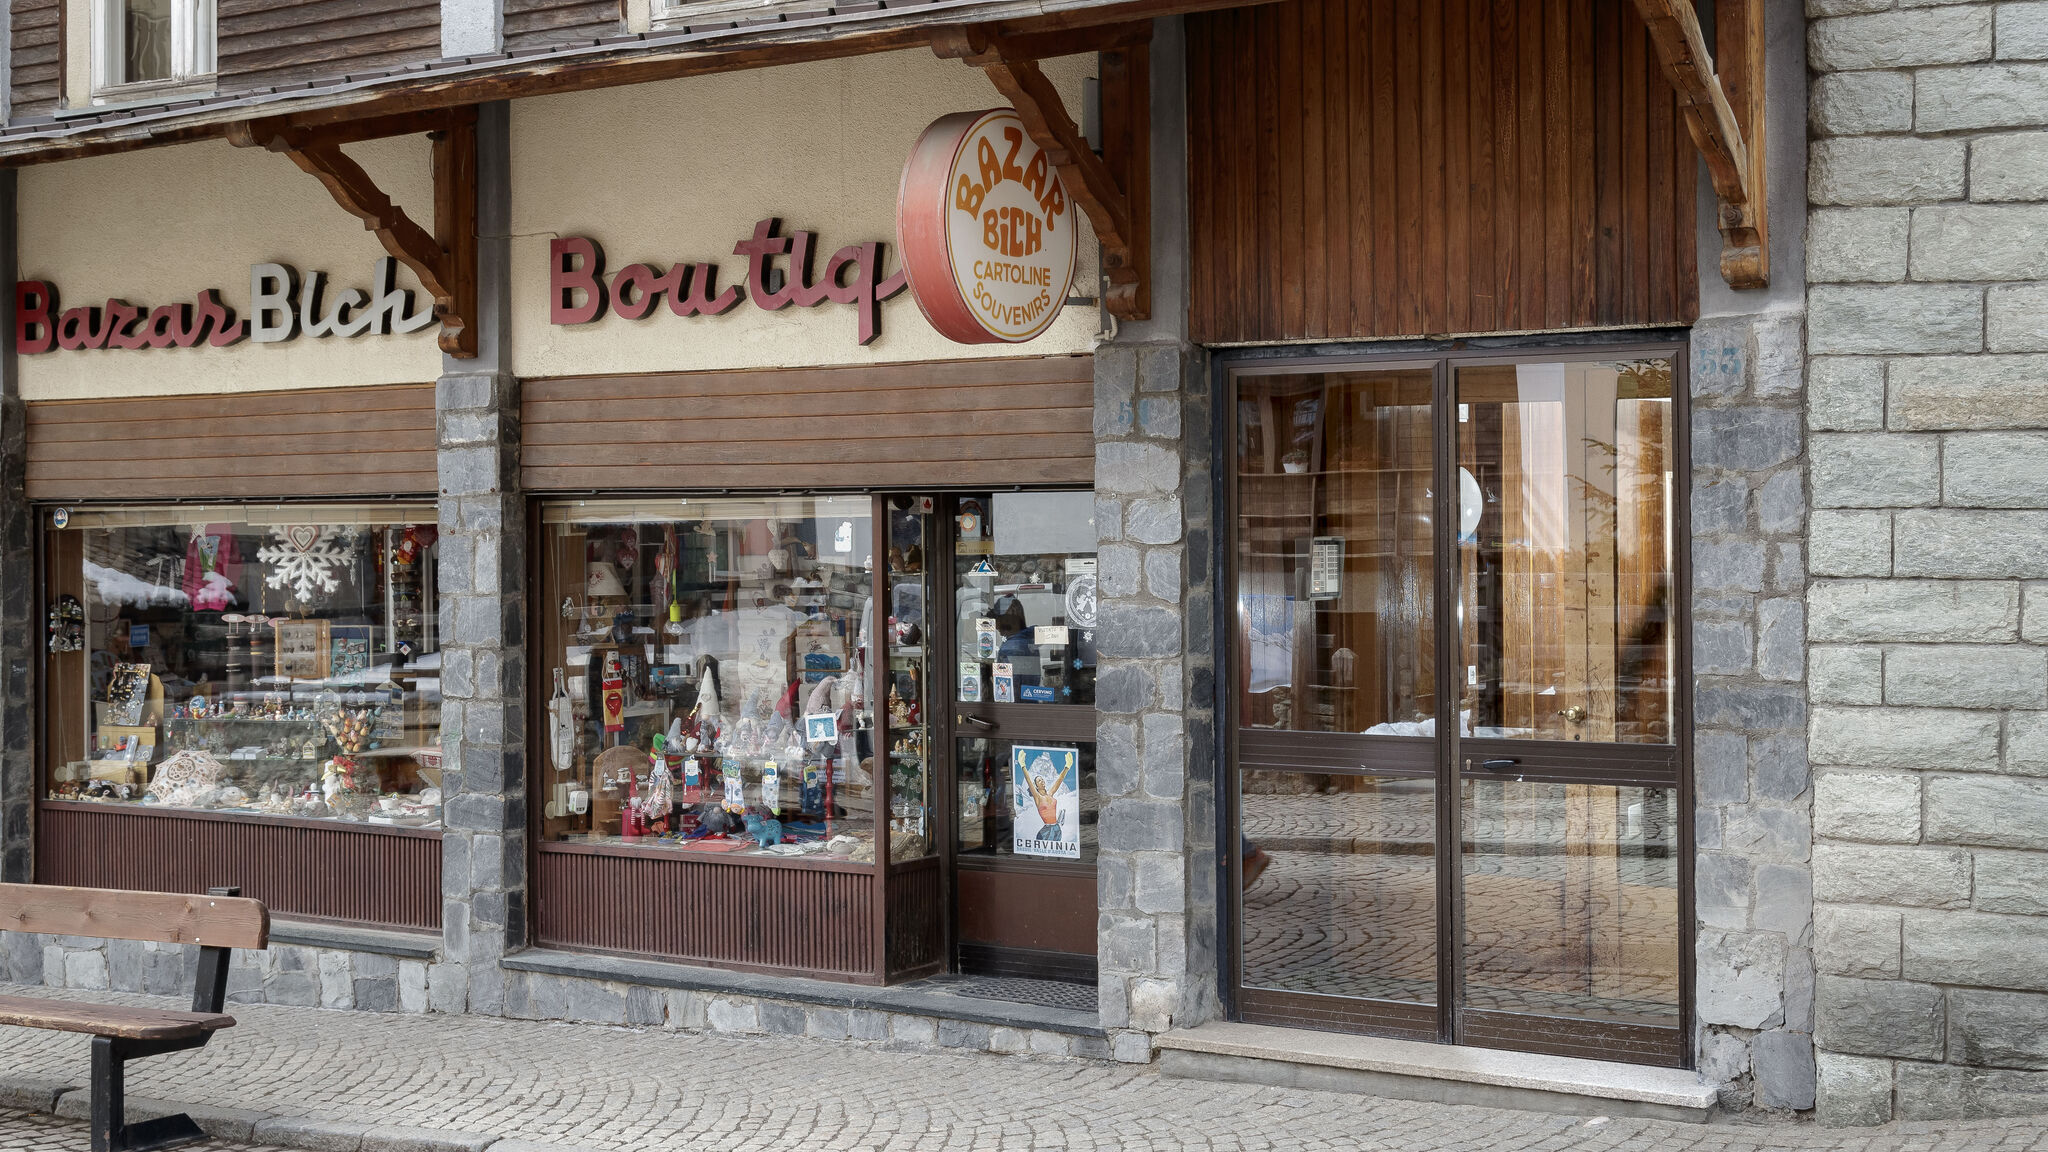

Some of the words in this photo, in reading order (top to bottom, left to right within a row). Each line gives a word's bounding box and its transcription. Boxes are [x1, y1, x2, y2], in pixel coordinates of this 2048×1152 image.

[956, 126, 1065, 231] BAZAR
[17, 280, 249, 354] Bazar
[250, 256, 438, 343] Bich
[550, 217, 909, 346] Boutiq
[973, 260, 1051, 287] CARTOLINE
[973, 281, 1051, 326] SOUVENIRS
[1017, 839, 1077, 851] CERVINIA
